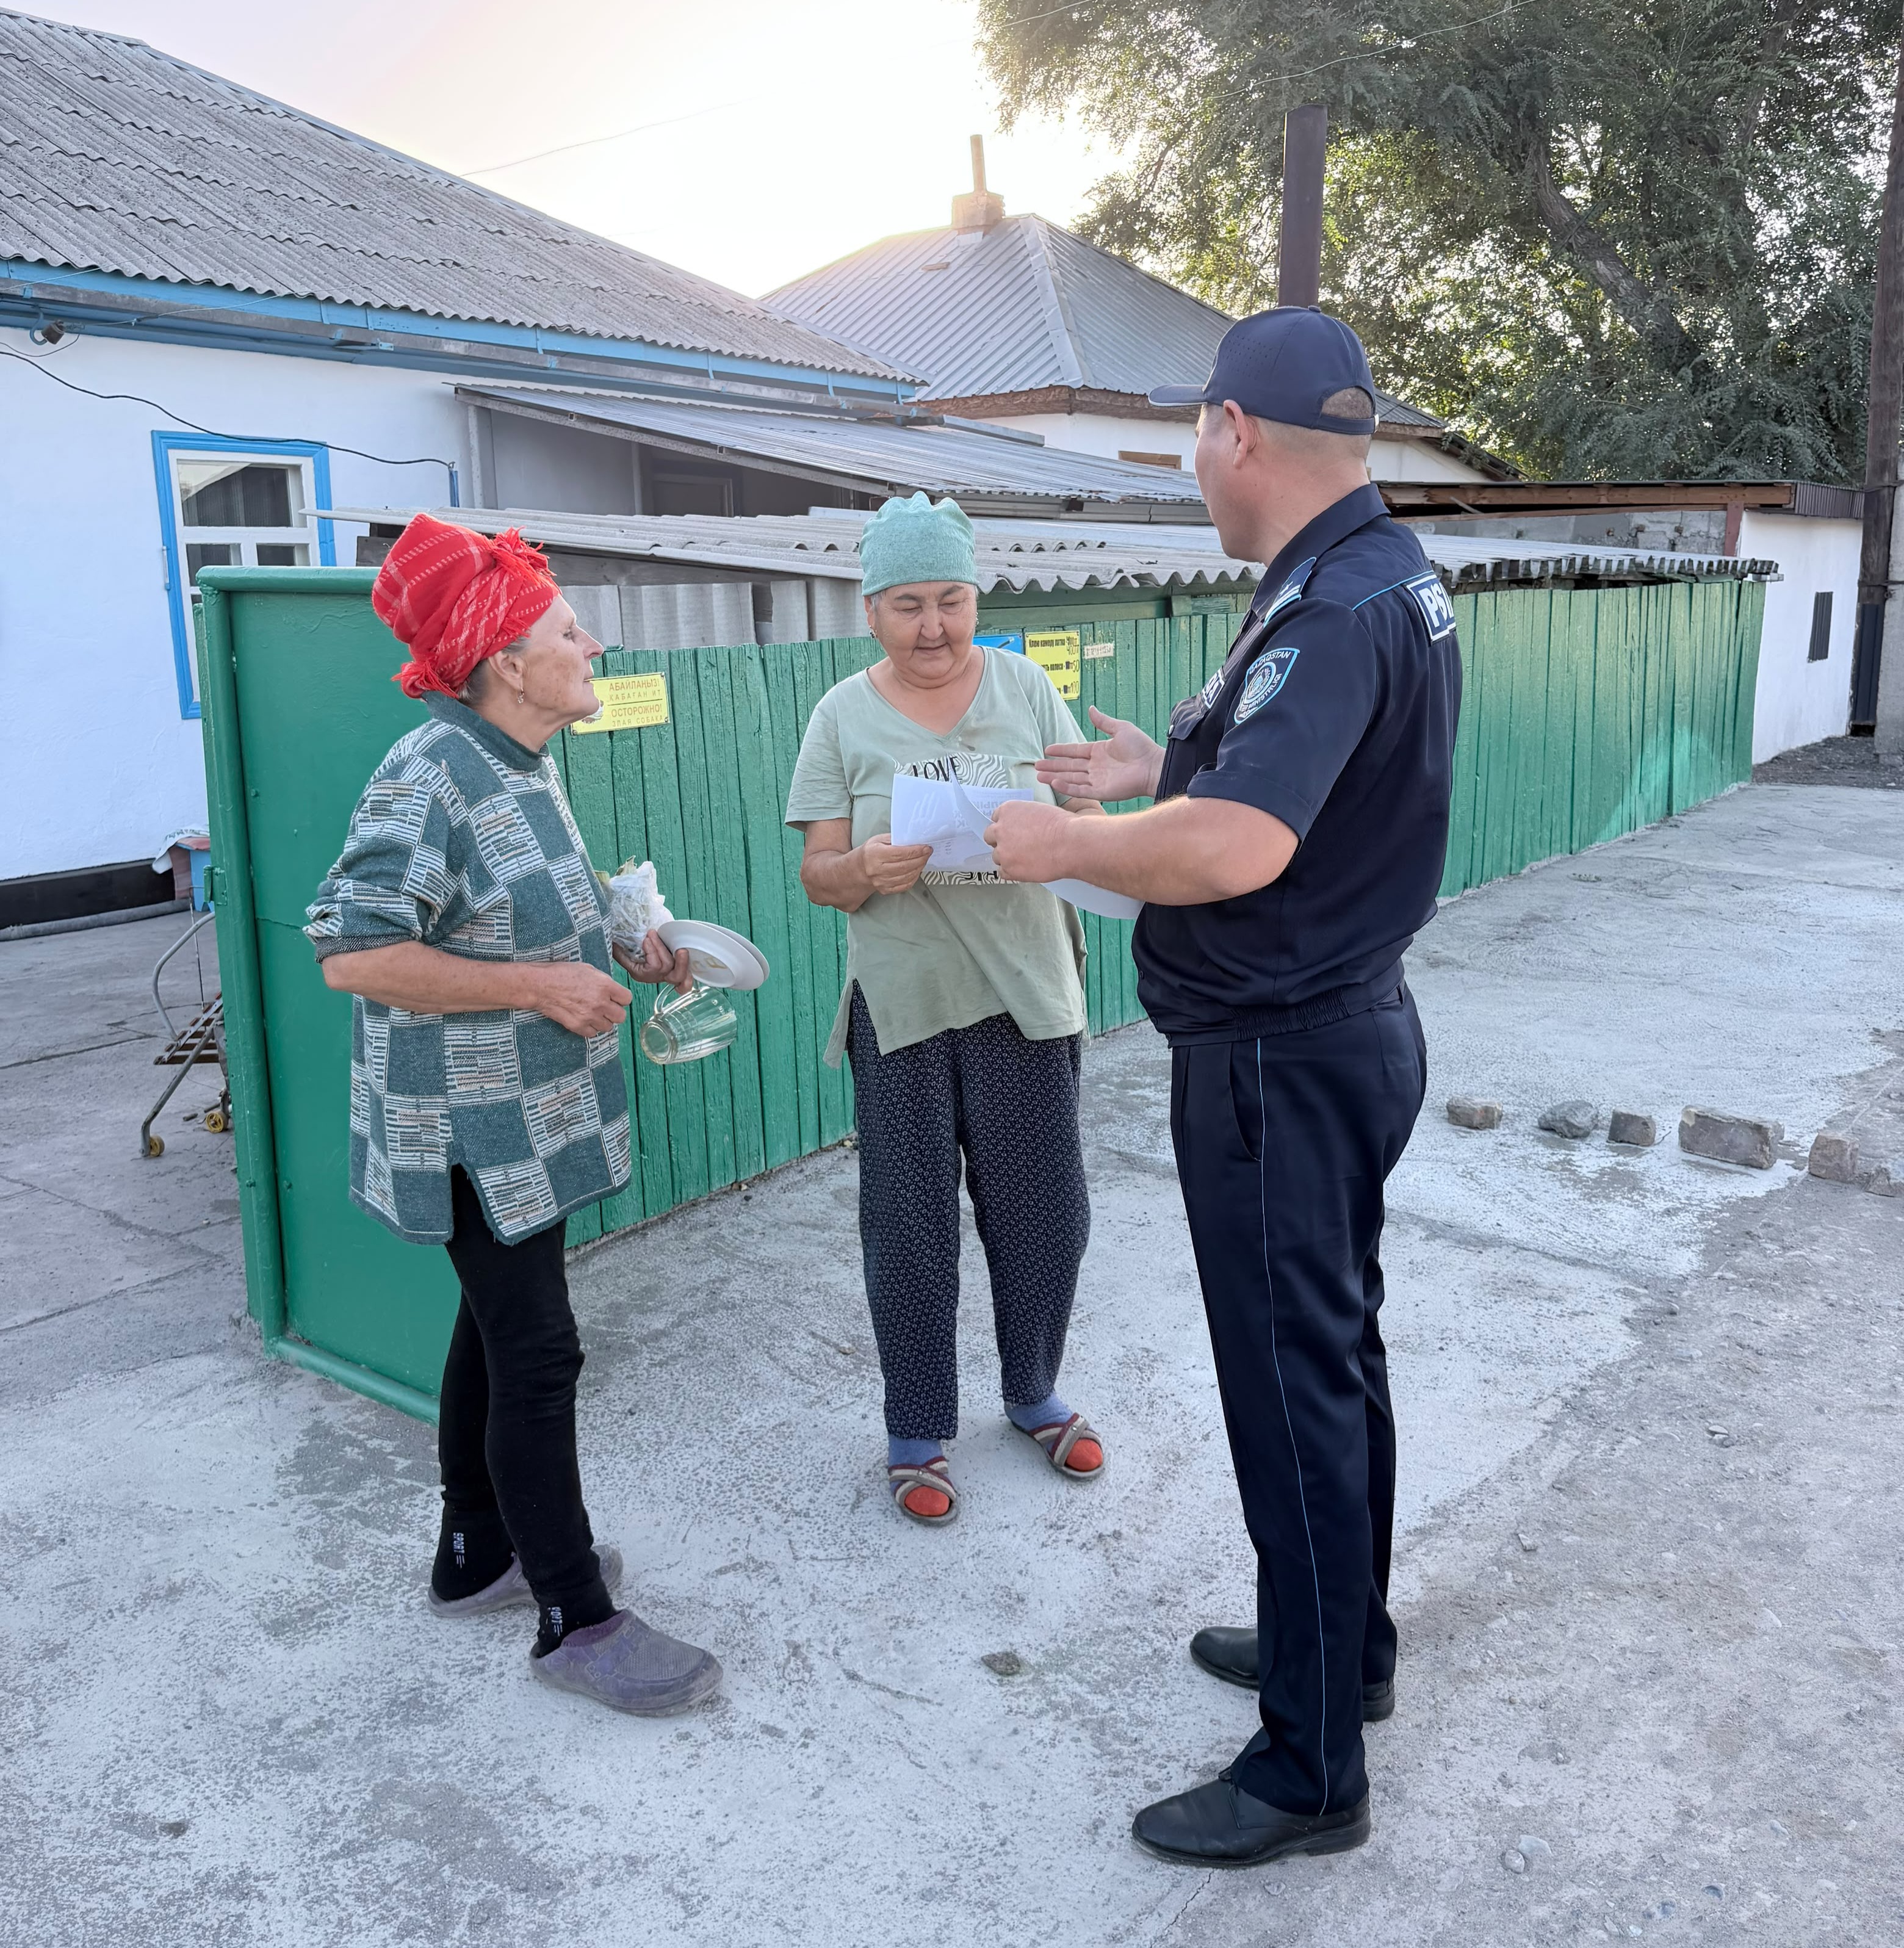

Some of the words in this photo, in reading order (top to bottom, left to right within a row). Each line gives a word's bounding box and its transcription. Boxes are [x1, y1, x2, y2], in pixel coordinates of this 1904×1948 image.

[611, 704, 662, 718] ОСТОРОЖНО!
[636, 715, 663, 724] СОБАКА
[453, 1532, 465, 1554] SPORT
